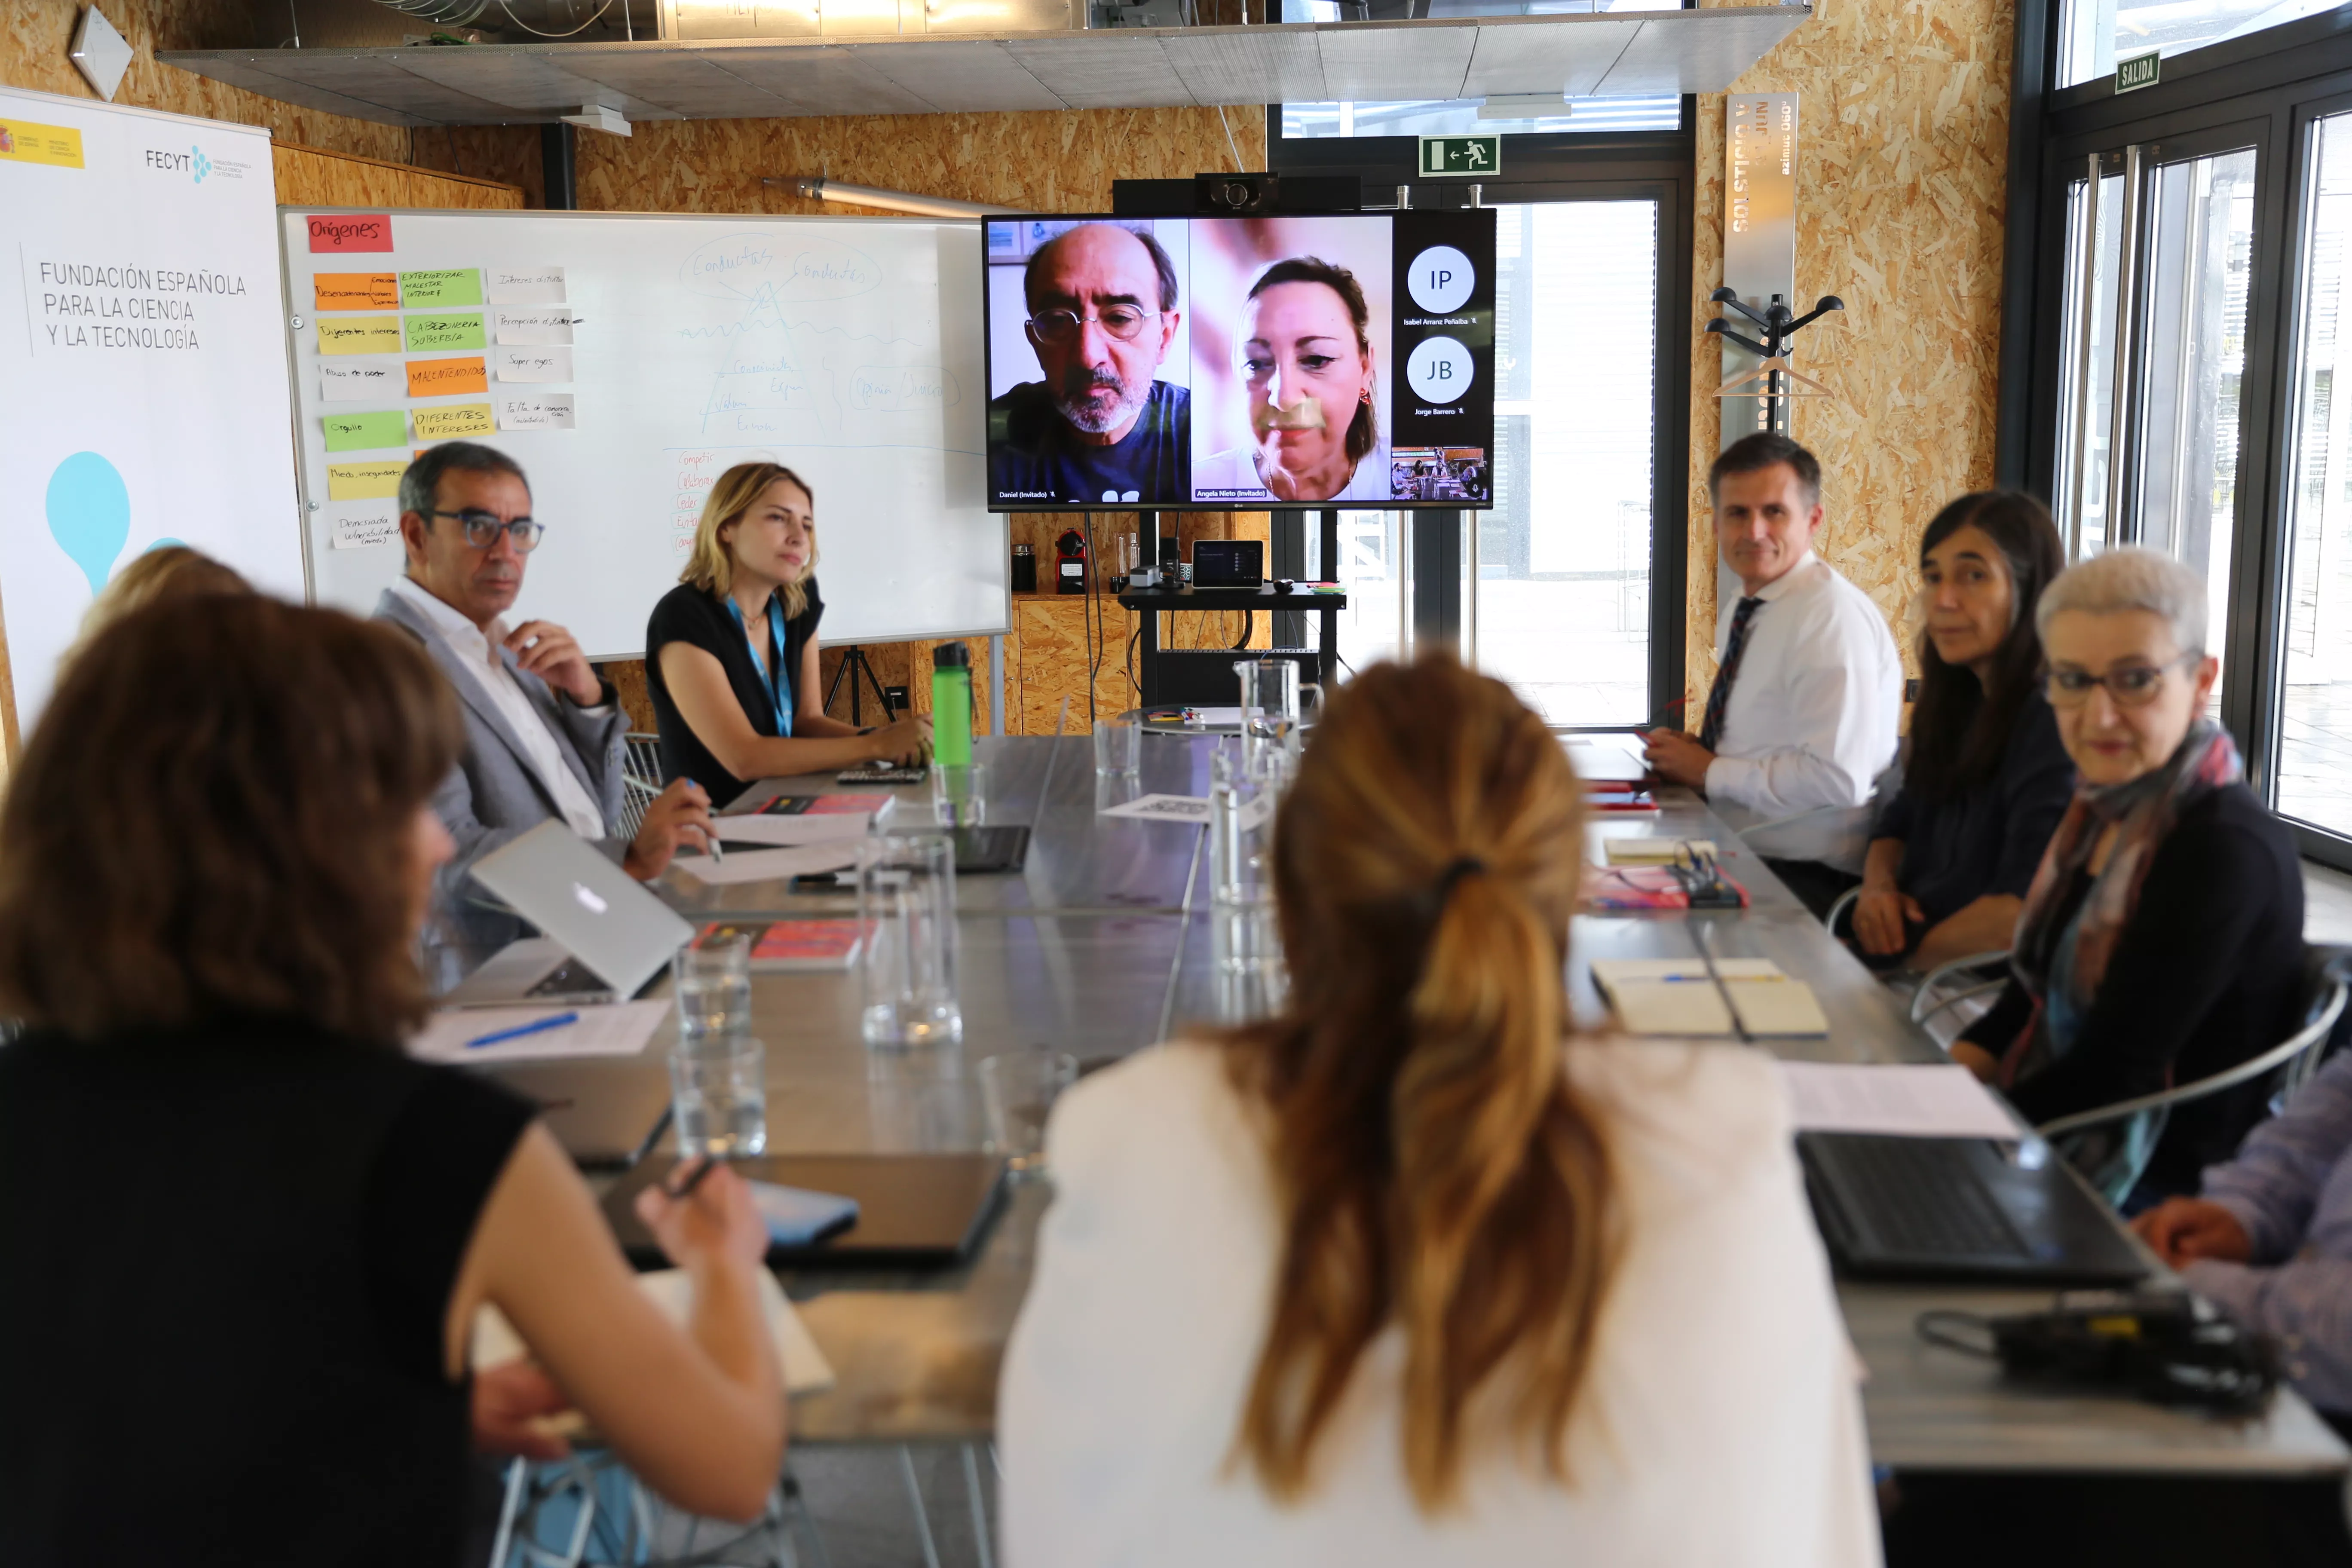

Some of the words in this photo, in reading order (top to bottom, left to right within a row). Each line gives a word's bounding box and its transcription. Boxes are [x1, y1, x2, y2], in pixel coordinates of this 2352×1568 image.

[2122, 58, 2153, 86] SALIDA
[146, 150, 190, 172] FECYT
[1780, 134, 1791, 175] azimut
[1733, 124, 1750, 233] SOLSTICIO
[311, 221, 380, 245] Orígenes
[693, 246, 773, 275] Conductas
[40, 262, 151, 290] FUNDACIÓN
[157, 269, 246, 296] ESPAÑOLA
[402, 272, 466, 281] EXTERIORIZAR
[498, 275, 533, 285] Intereses
[1431, 270, 1452, 290] IP
[404, 281, 443, 290] MALESTAR
[44, 293, 96, 317] PARA
[101, 297, 124, 318] LA
[129, 298, 194, 322] CIENCIA
[500, 314, 538, 328] Percepción
[46, 324, 58, 346] Y
[65, 325, 88, 347] LA
[92, 324, 199, 349] TECNOLOGÍA
[320, 326, 365, 339] Diferentes
[412, 333, 465, 347] SOBERBIA
[508, 354, 531, 370] Super
[535, 358, 554, 369] egos
[326, 368, 346, 377] Abuso
[411, 365, 487, 384] MALENTENDIDOS
[1427, 361, 1452, 380] JB
[508, 401, 530, 413] Falta
[416, 410, 485, 425] DIFERENTES
[331, 423, 363, 433] Orgullo
[423, 424, 488, 435] INTERESES
[679, 451, 715, 471] Competir
[359, 469, 401, 479] inseguridades
[678, 472, 714, 490] Colaborar
[677, 494, 698, 510] Ceder
[339, 515, 389, 528] Demasiada
[361, 537, 387, 545] (miedo)
